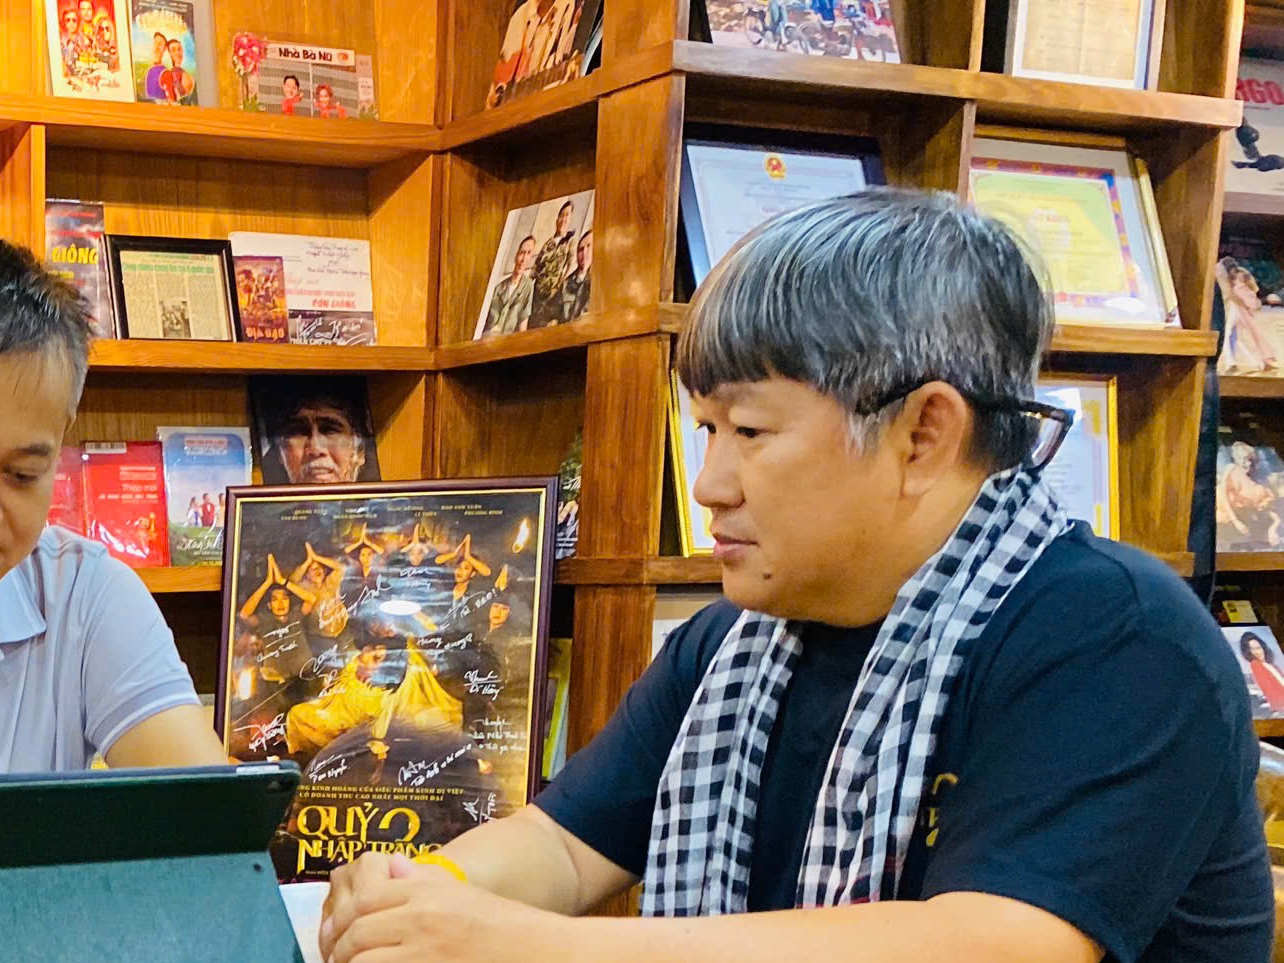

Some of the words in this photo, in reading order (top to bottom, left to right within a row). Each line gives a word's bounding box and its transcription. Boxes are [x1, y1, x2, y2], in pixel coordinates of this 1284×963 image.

[278, 47, 300, 58] Nhà
[302, 49, 316, 60] Bà
[297, 802, 379, 847] QUỶ
